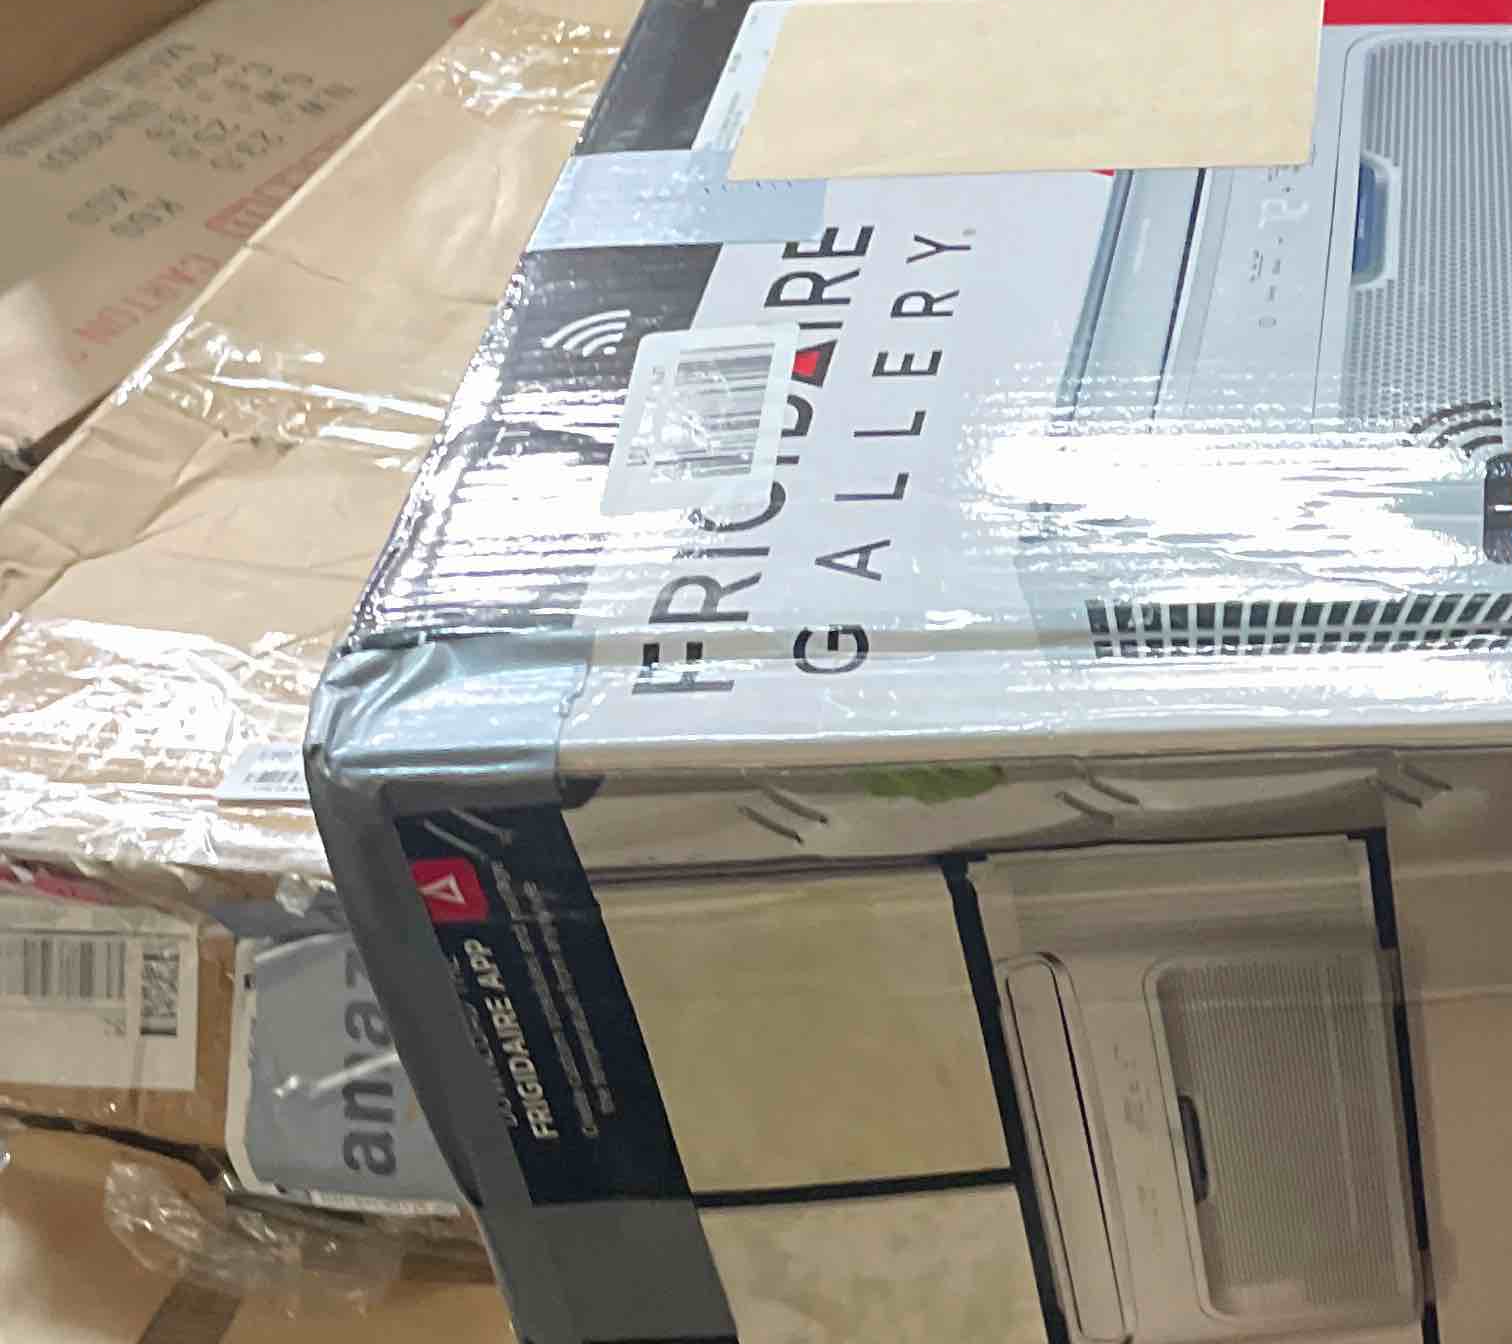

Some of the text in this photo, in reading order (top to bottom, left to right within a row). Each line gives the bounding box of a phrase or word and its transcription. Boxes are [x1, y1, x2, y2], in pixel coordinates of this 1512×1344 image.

[792, 233, 972, 674] GALLERY
[462, 938, 506, 992] APP
[484, 994, 560, 1140] FRIGIDAIRE
